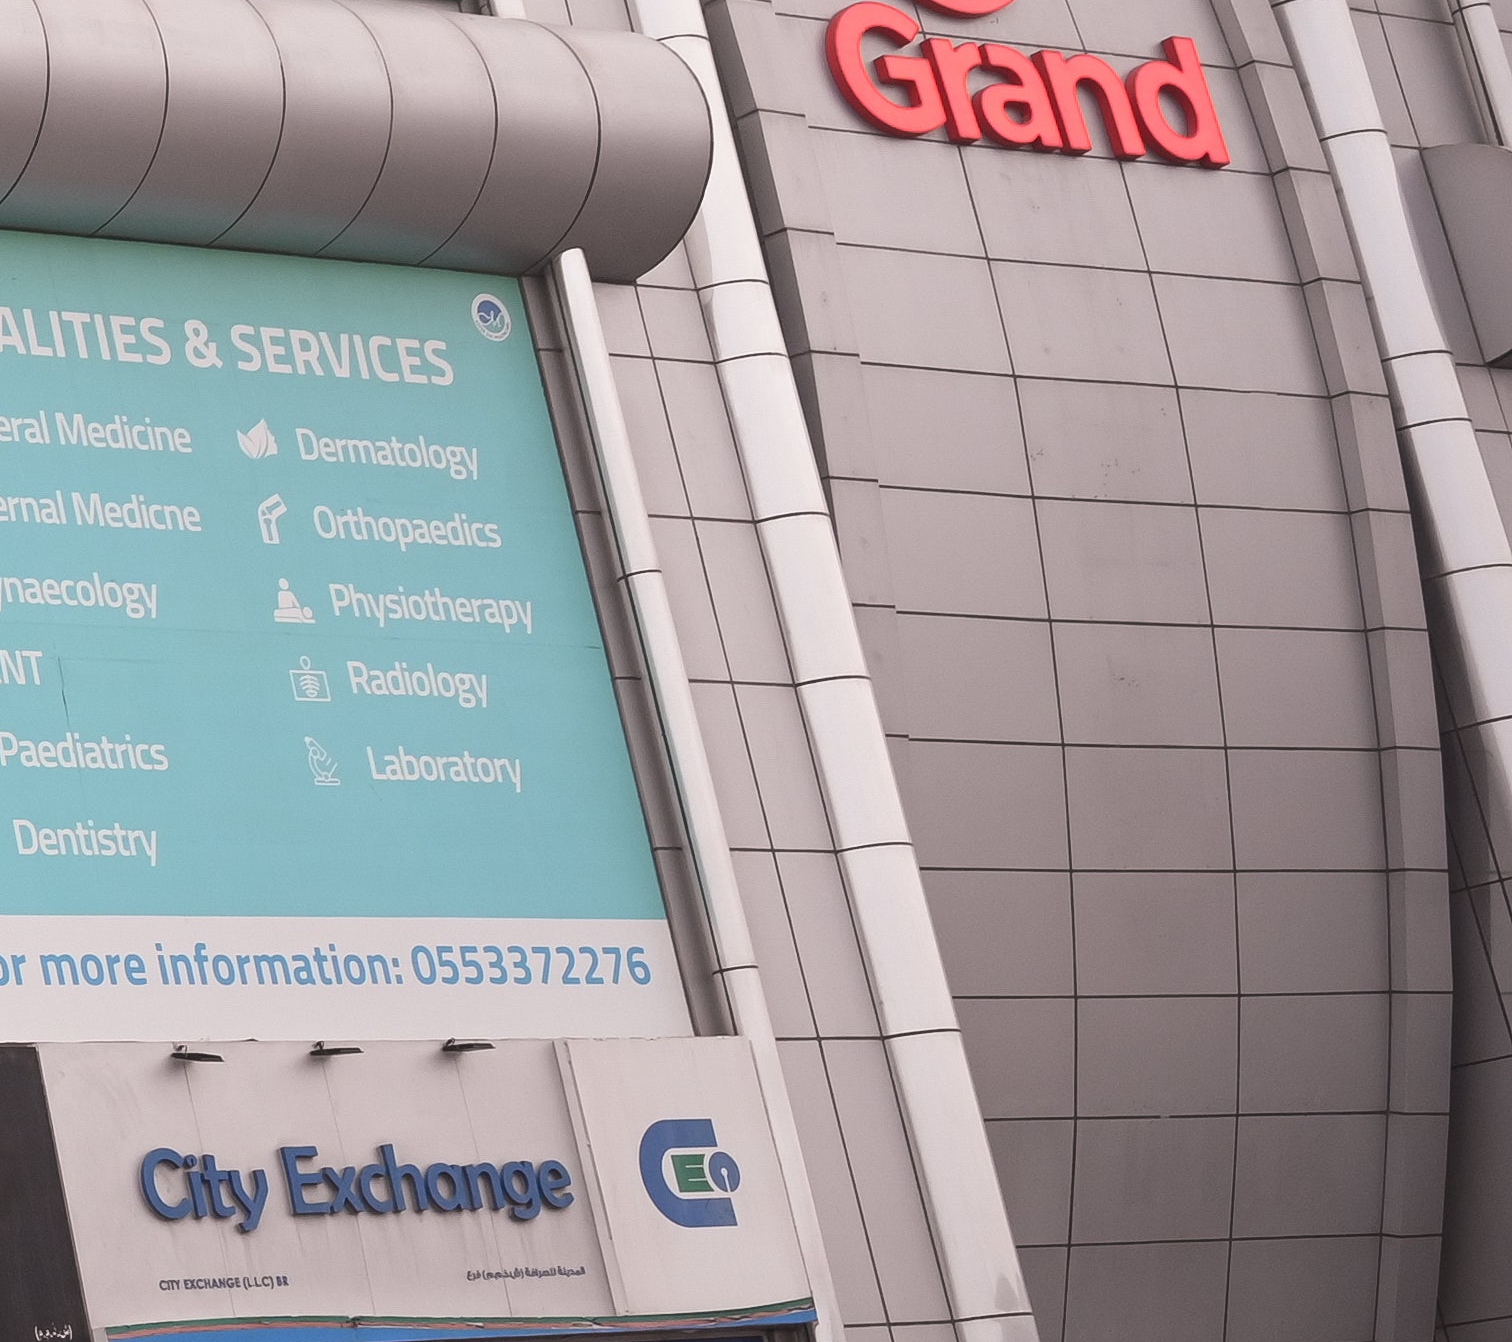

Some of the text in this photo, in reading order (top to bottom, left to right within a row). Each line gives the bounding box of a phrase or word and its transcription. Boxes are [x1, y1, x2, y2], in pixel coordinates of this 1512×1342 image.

[824, 0, 1232, 171] Grand
[182, 317, 225, 371] &
[228, 322, 457, 389] SERVICES
[54, 409, 194, 455] Medicine
[295, 425, 481, 481] Dermatology
[311, 504, 504, 554] Orthopaedics
[328, 580, 534, 635] Physiotherapy
[345, 659, 490, 710] Radiology
[366, 744, 523, 795] Laboratory
[11, 816, 159, 867] Dentistry
[40, 950, 150, 988] more
[154, 941, 406, 989] information:
[409, 943, 653, 988] 0553372276
[139, 1142, 576, 1235] City Exchange
[158, 1276, 242, 1292] CITY EXCHANGE
